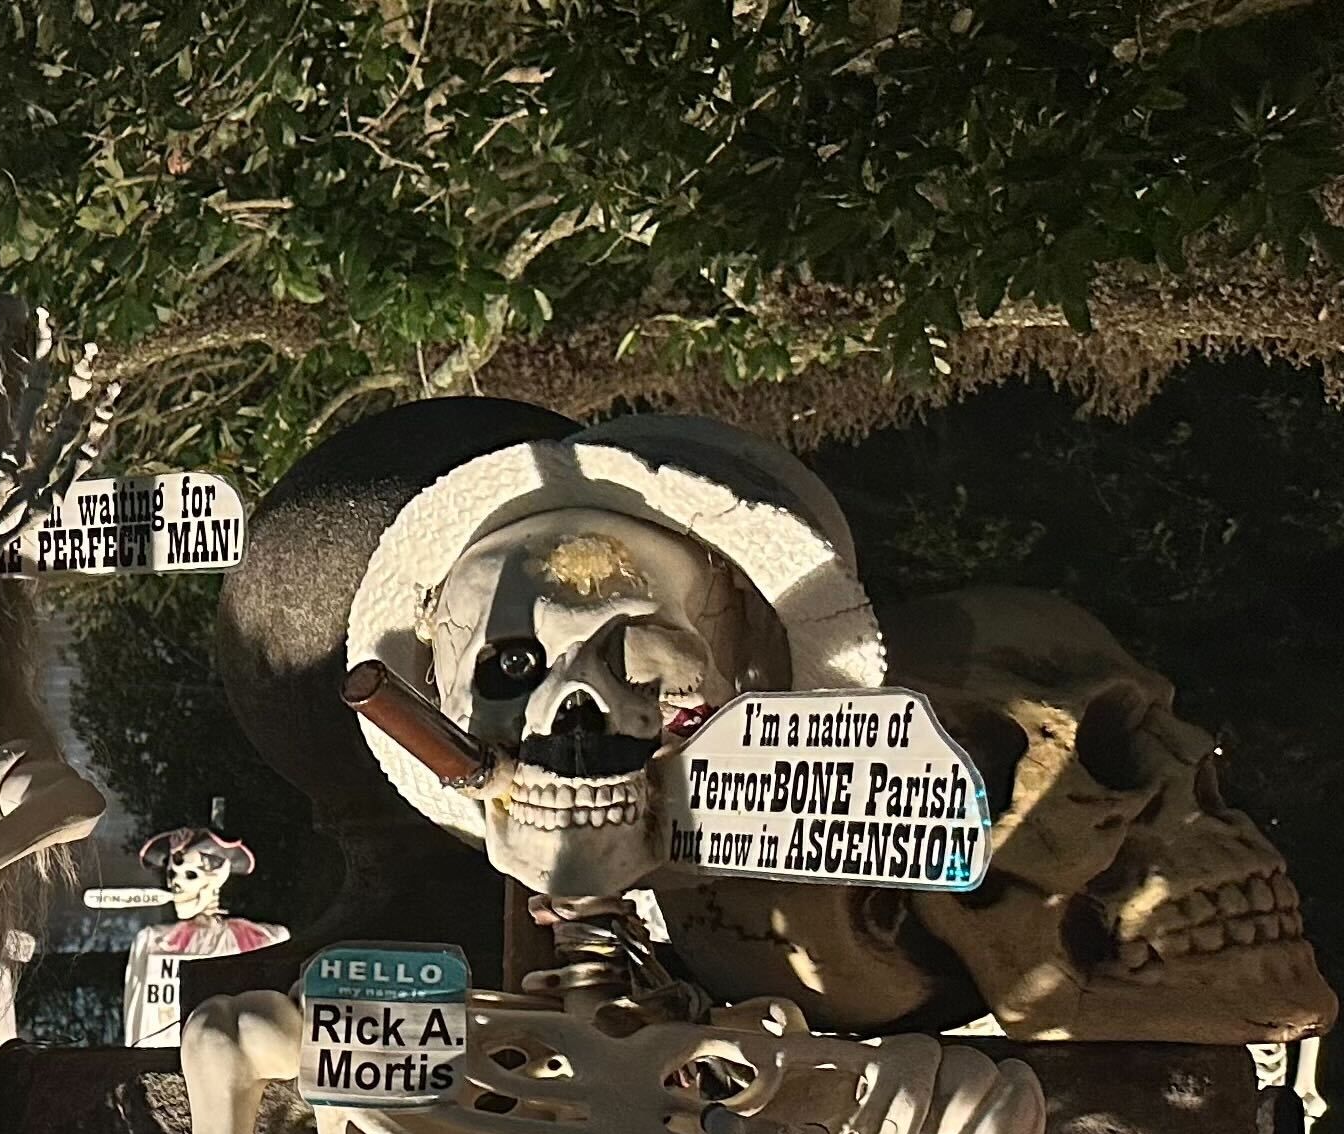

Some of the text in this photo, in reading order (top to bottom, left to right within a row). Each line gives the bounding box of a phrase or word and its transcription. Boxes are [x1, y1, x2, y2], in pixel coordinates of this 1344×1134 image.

[78, 481, 164, 531] waiting
[181, 475, 216, 519] for
[37, 523, 151, 572] PERFECT
[167, 518, 240, 565] MAN!
[742, 700, 915, 749] I'm a native of
[689, 758, 969, 821] TerrorBONE Parish
[670, 818, 979, 883] but now in ASCENSION
[319, 958, 443, 985] HELLO
[311, 1003, 464, 1047] Rick A.
[316, 1048, 454, 1092] Mortis
